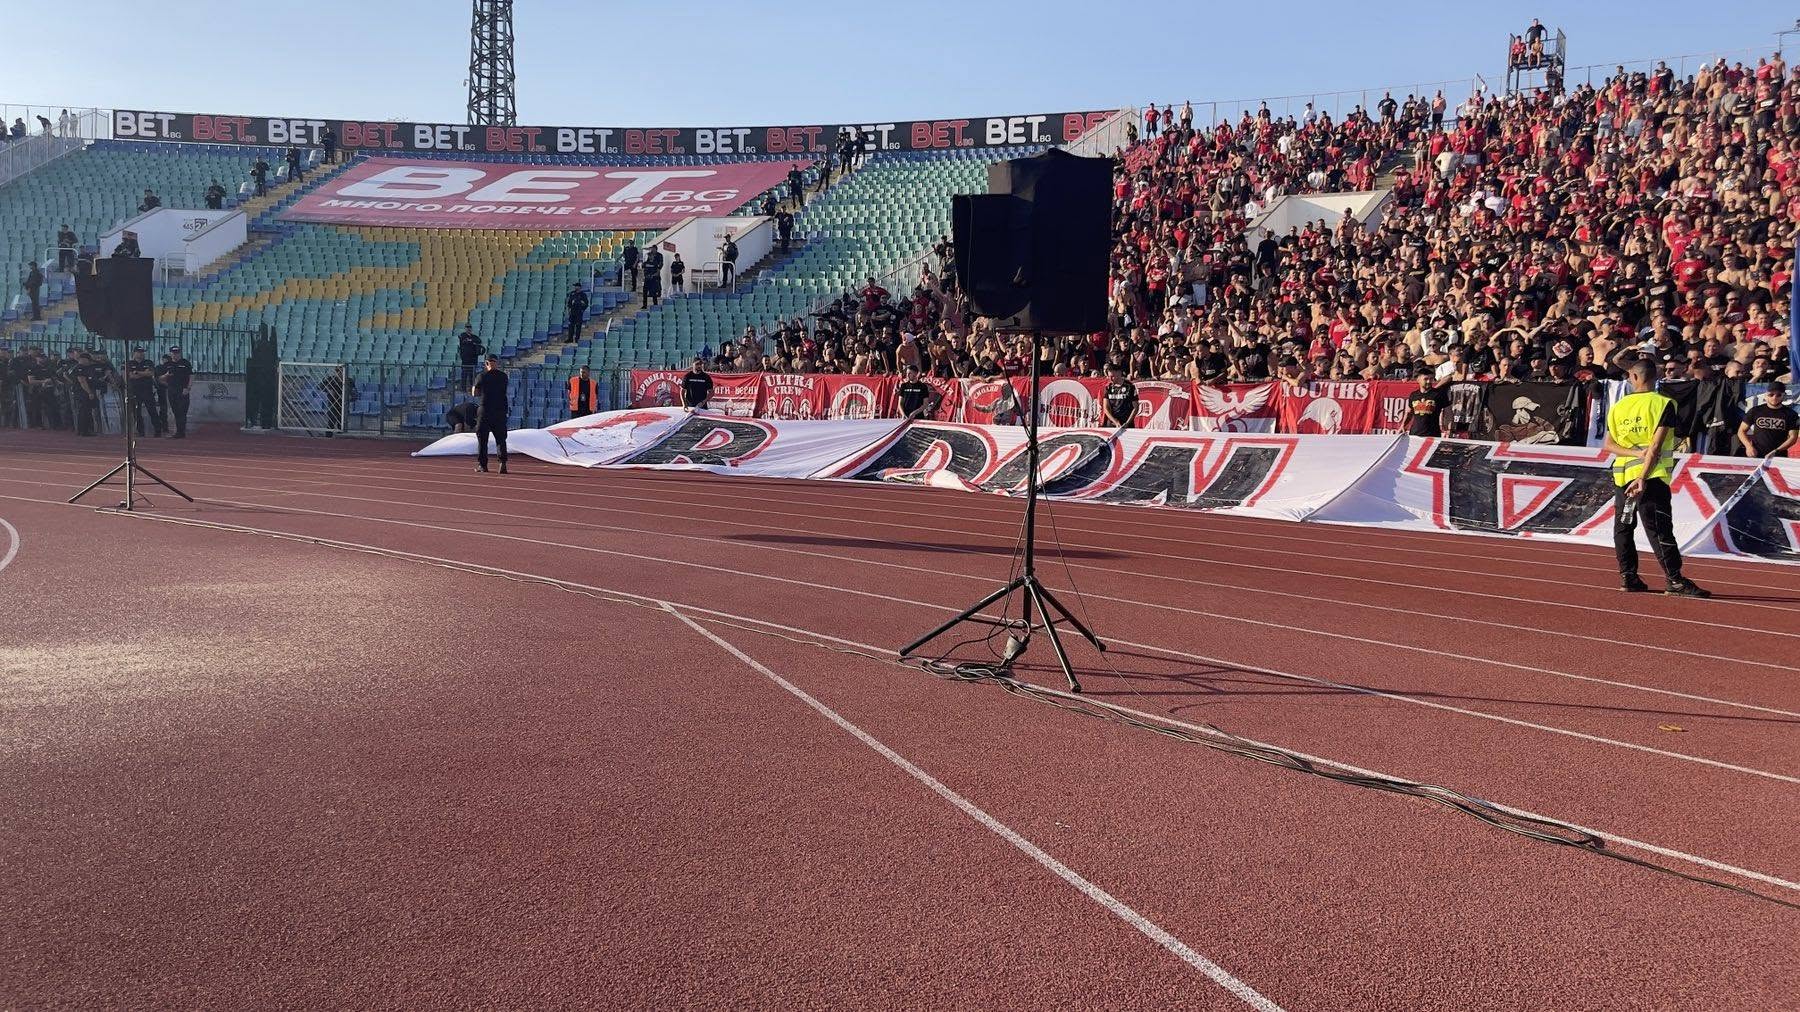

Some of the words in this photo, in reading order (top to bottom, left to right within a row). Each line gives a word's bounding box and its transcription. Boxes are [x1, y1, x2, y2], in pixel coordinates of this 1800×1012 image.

[320, 199, 443, 212] МНОГО
[447, 204, 573, 215] ПОВЕЧЕ
[580, 206, 628, 215] ОТ
[633, 204, 712, 214] ИГРА
[765, 375, 814, 390] ULTRA
[774, 386, 804, 395] CREW
[1282, 381, 1370, 400] YOUTHS
[1756, 417, 1786, 430] CSKA
